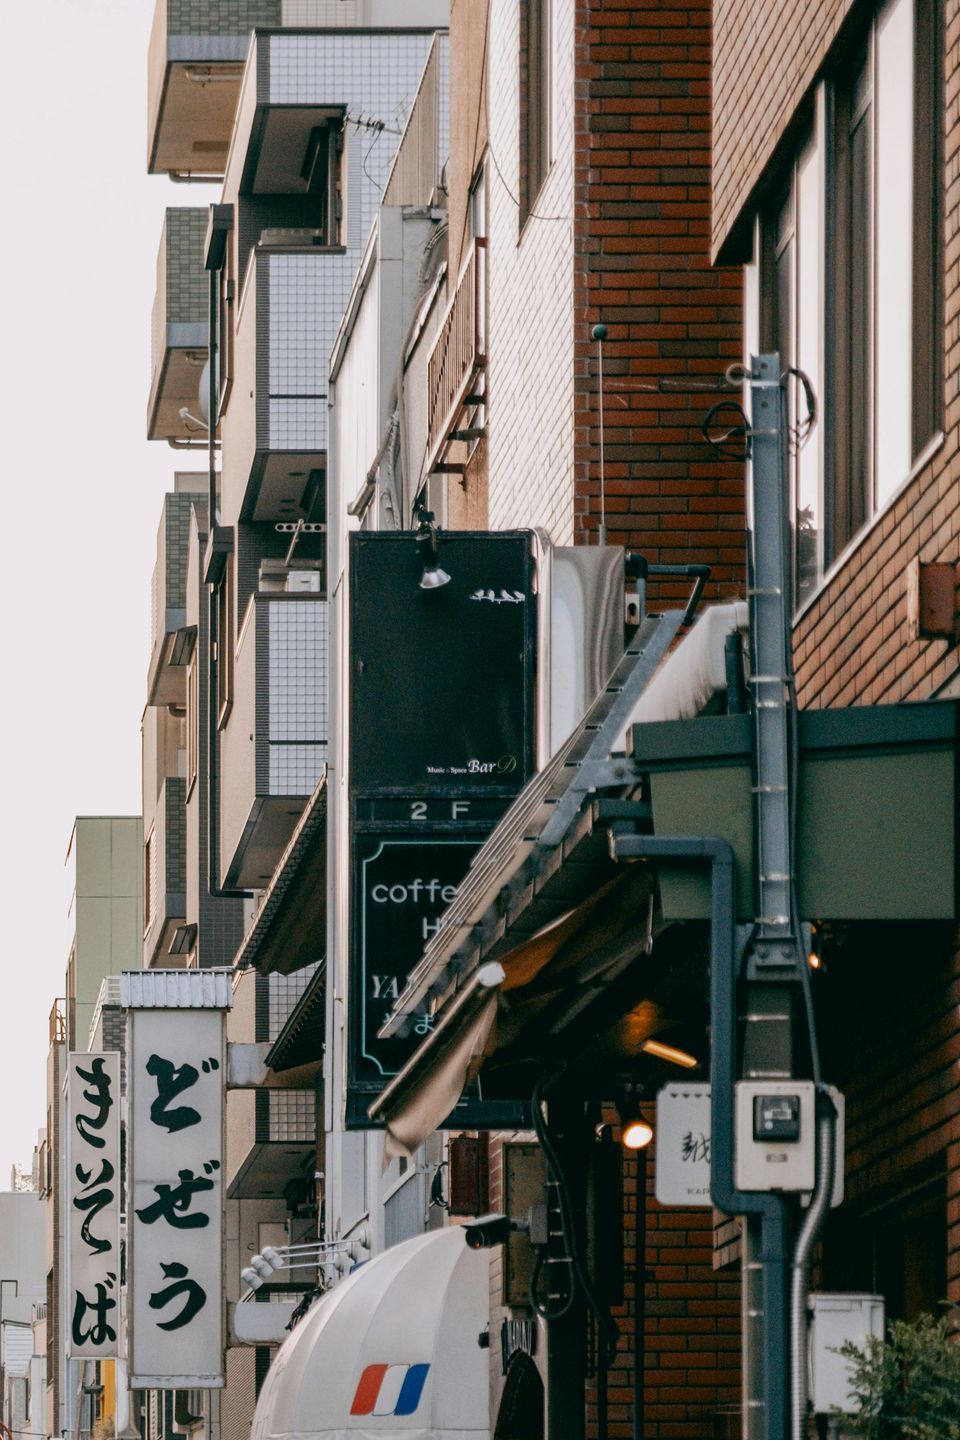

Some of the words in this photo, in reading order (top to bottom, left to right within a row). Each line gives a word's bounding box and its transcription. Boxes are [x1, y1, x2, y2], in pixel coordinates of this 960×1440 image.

[427, 766, 445, 774] Music
[451, 767, 467, 775] Space
[468, 759, 496, 773] Bar
[135, 1054, 220, 1331] どぜう
